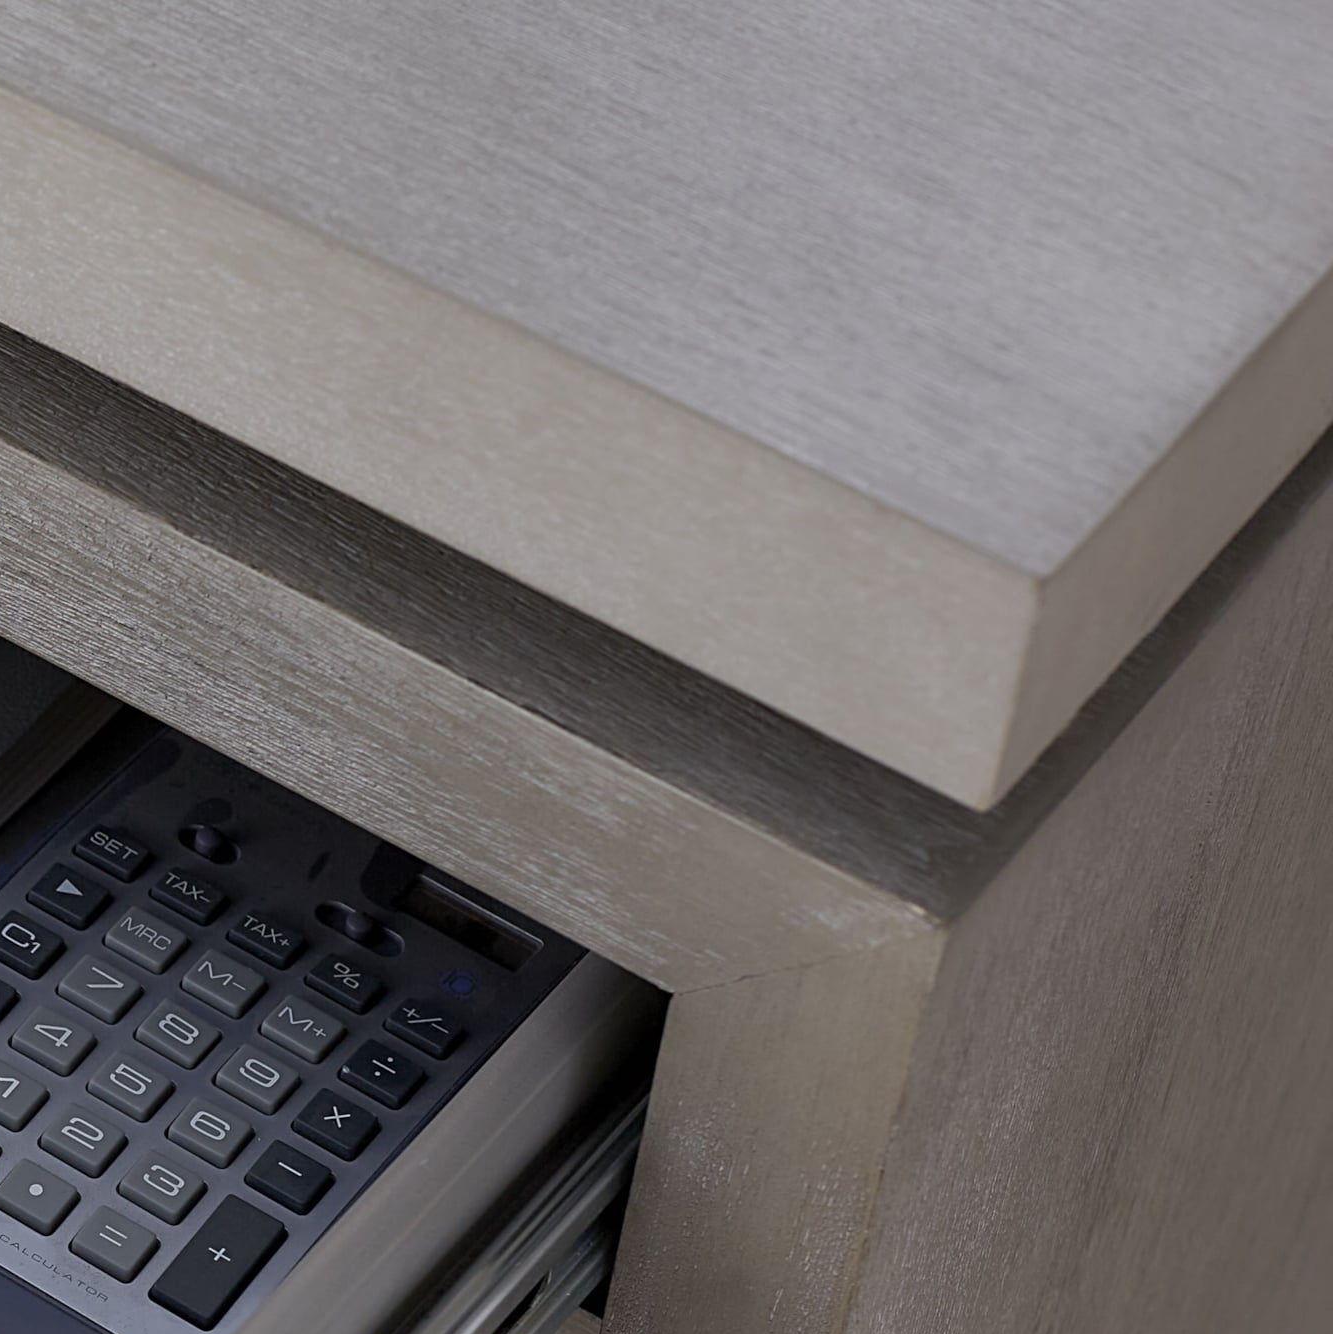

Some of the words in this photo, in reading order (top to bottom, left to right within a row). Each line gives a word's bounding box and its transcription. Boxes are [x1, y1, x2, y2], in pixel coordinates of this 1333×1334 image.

[89, 831, 138, 860] SET
[164, 872, 211, 903] TAX-
[0, 922, 42, 954] C1
[120, 916, 172, 951] MRC
[243, 914, 290, 947] TAX+
[85, 966, 125, 990] 7
[197, 960, 246, 991] M-
[333, 962, 361, 990] %
[33, 1023, 73, 1048] 4
[158, 1013, 200, 1046] 8
[277, 1006, 327, 1038] M+
[109, 1063, 153, 1096] 5
[239, 1058, 280, 1088] 9
[61, 1116, 105, 1150] 2
[189, 1110, 231, 1141] 6
[142, 1164, 186, 1197] 3
[208, 1247, 232, 1263] +
